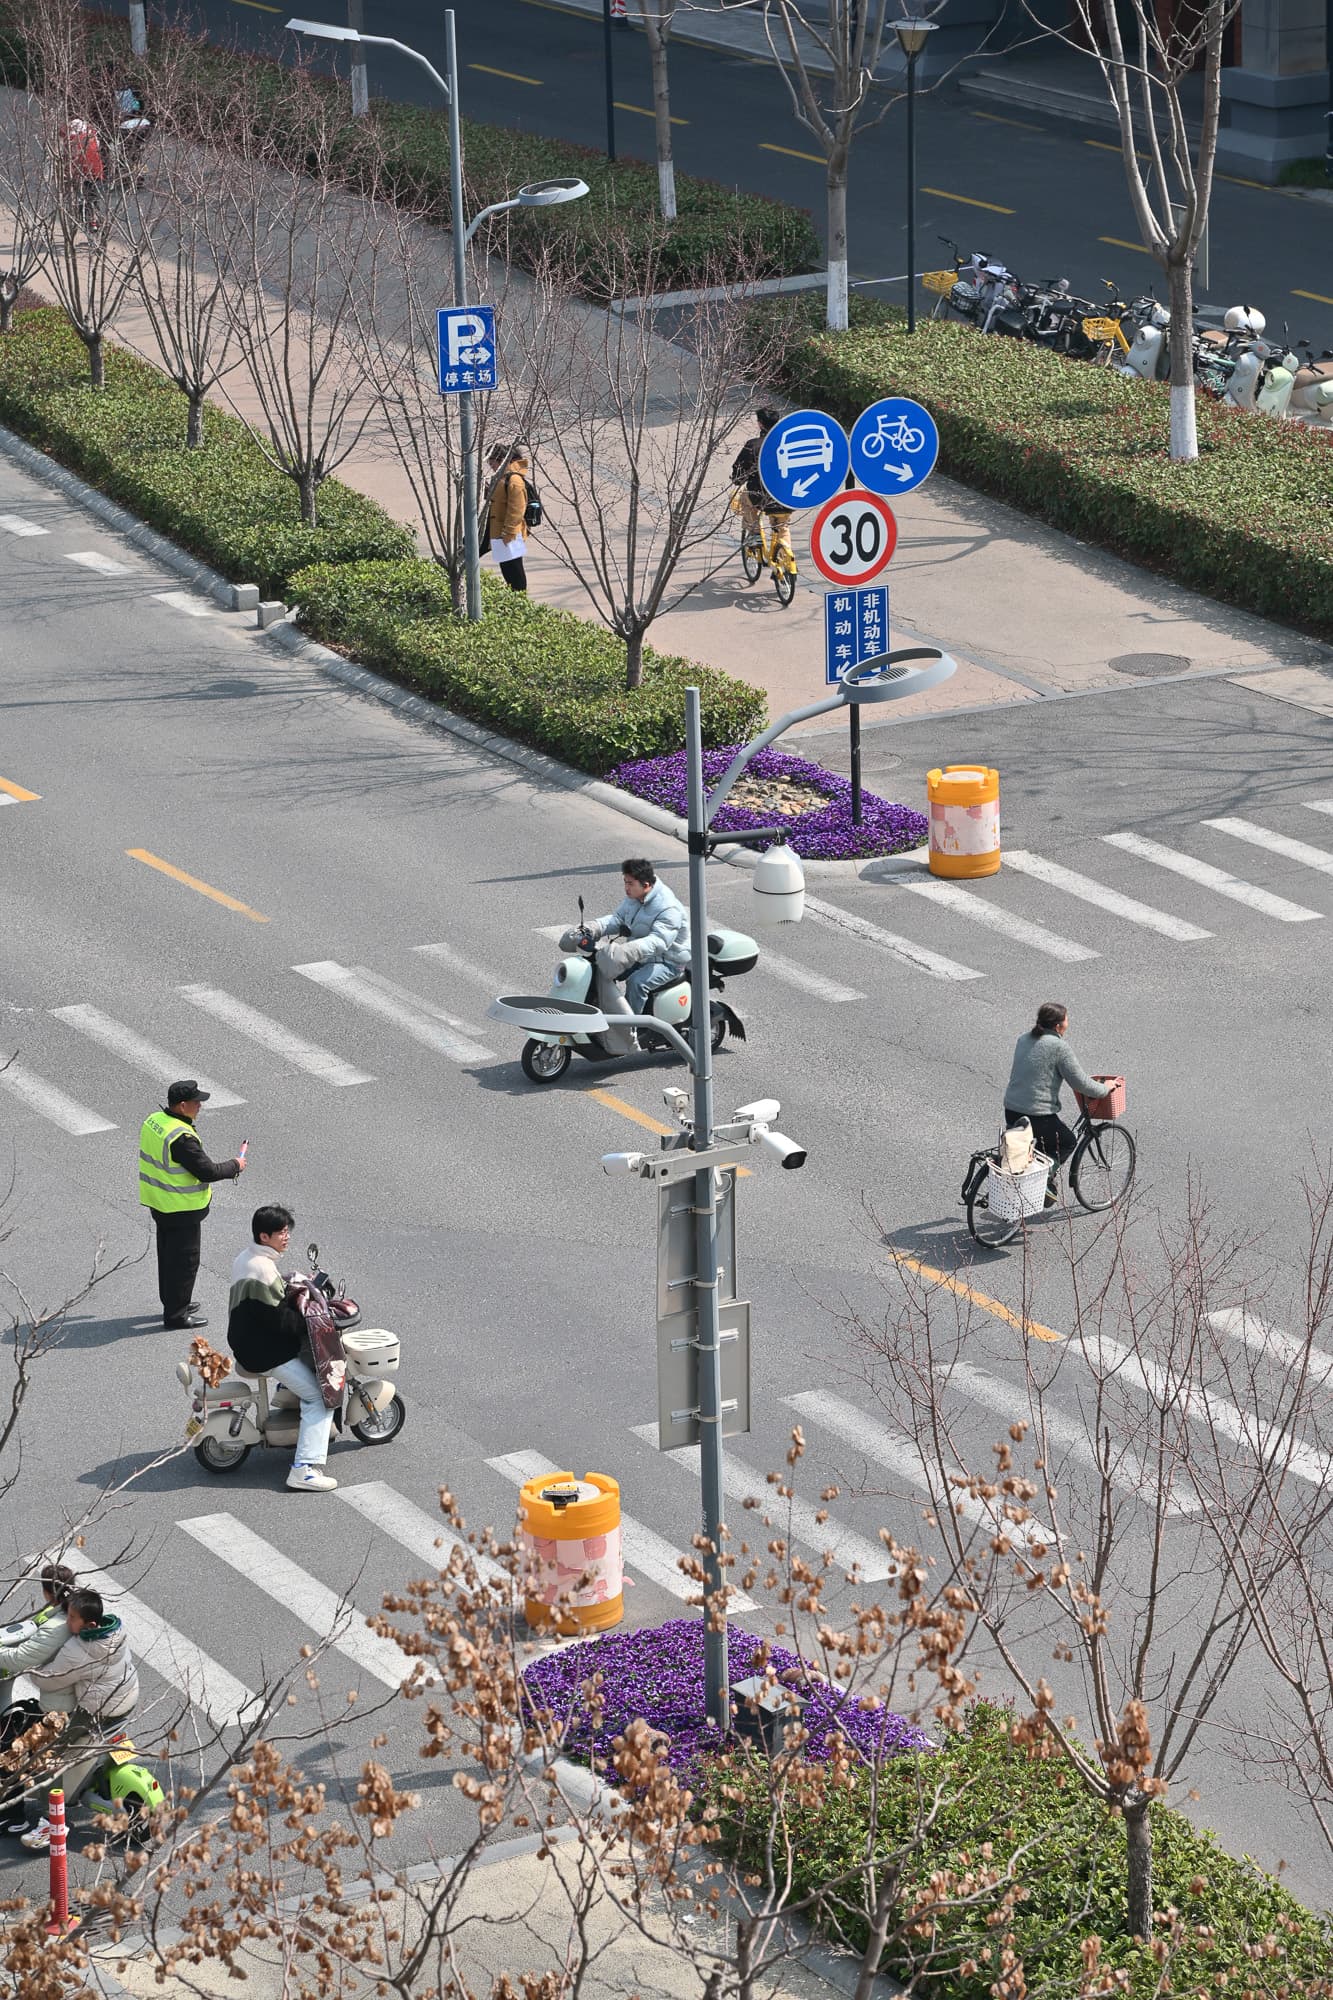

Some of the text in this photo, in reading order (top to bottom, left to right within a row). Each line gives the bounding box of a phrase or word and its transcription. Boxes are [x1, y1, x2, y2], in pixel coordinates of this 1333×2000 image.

[448, 315, 486, 366] P
[445, 369, 492, 387] 停车场
[829, 512, 881, 566] 30
[834, 597, 852, 659] 机动车
[863, 593, 881, 655] 非机动车
